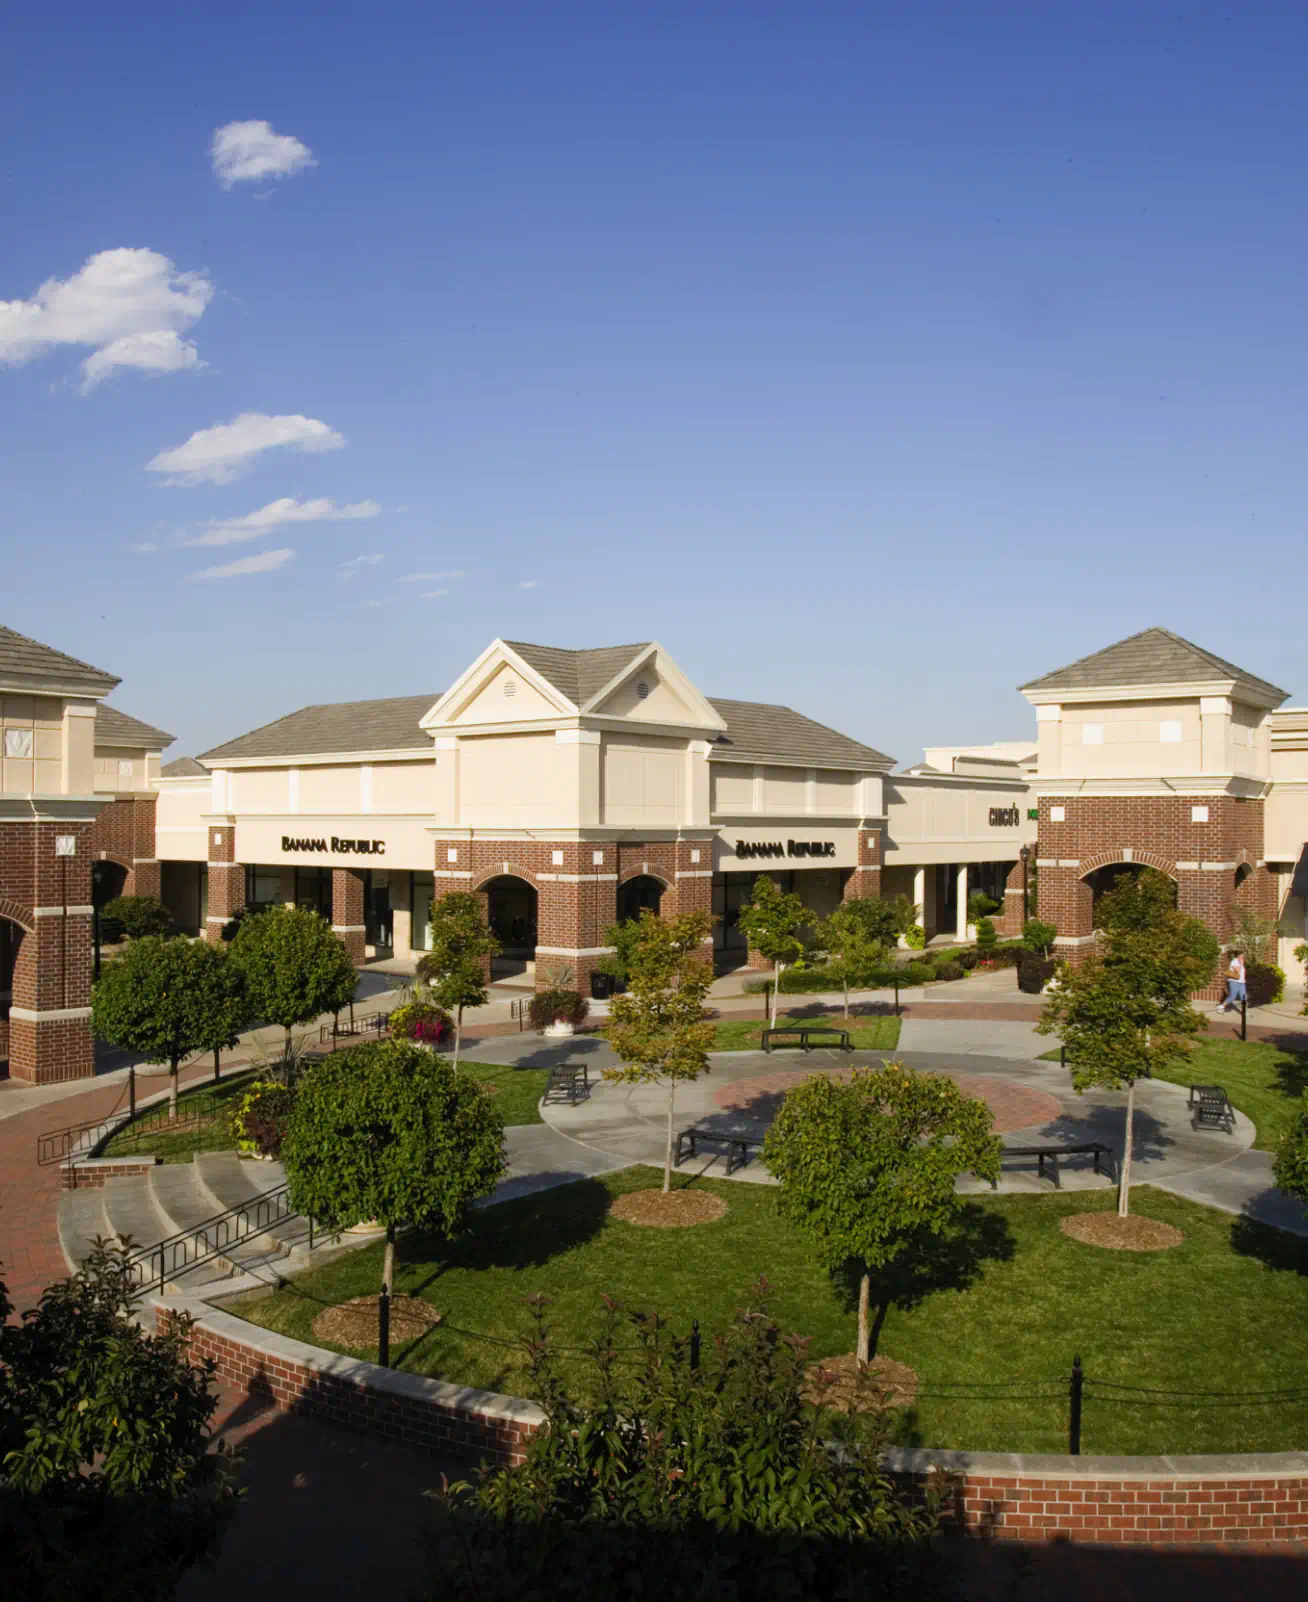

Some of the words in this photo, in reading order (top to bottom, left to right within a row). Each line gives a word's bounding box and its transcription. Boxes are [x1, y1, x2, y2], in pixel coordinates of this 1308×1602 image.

[282, 836, 328, 852] BANANA
[331, 836, 385, 854] REPUBLIC
[736, 840, 785, 858] BANANA
[788, 840, 835, 857] REPUBLIC
